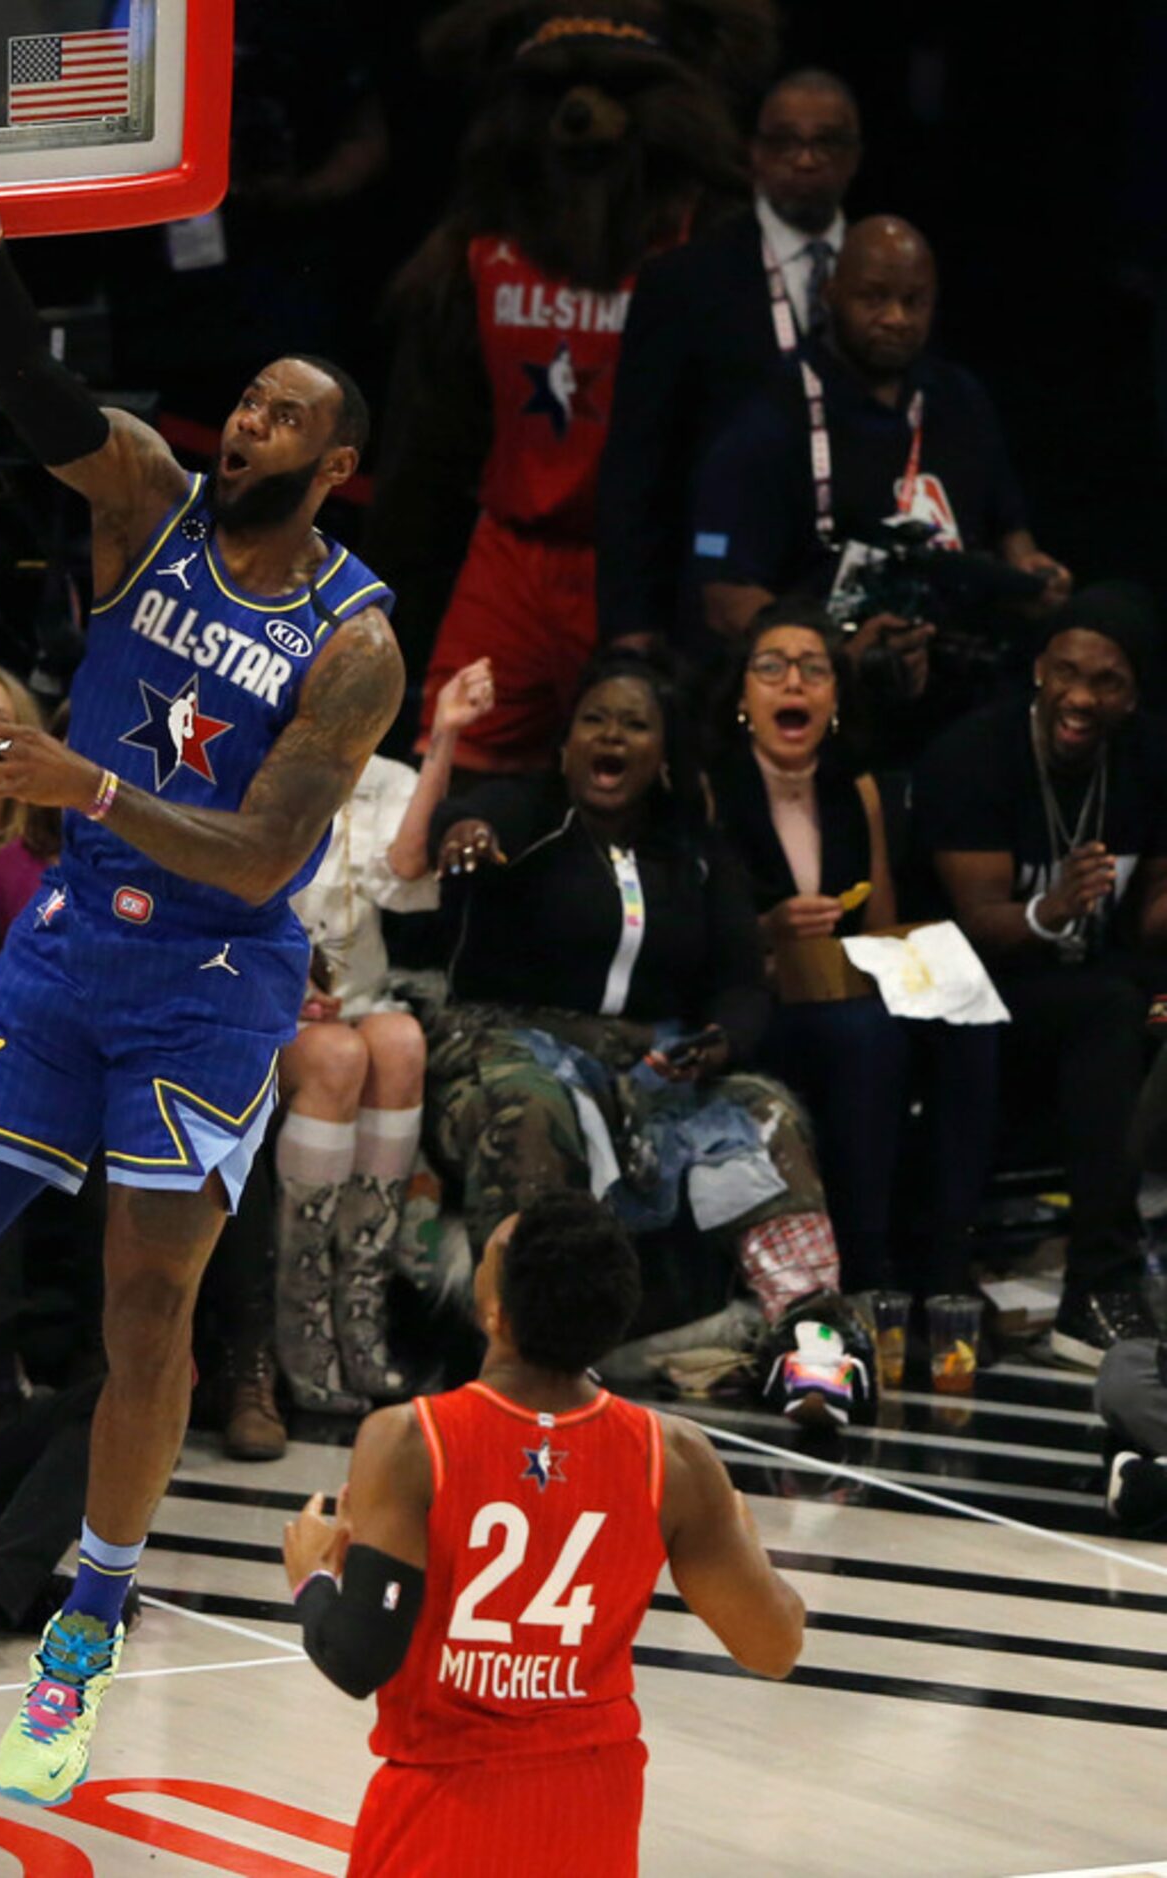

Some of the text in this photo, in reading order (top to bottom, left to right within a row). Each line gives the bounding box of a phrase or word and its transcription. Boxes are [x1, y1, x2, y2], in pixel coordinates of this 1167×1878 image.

[131, 588, 294, 708] ALL-STAR
[272, 624, 305, 655] KIA
[447, 1501, 608, 1647] 24
[437, 1643, 587, 1699] MITCHELL
